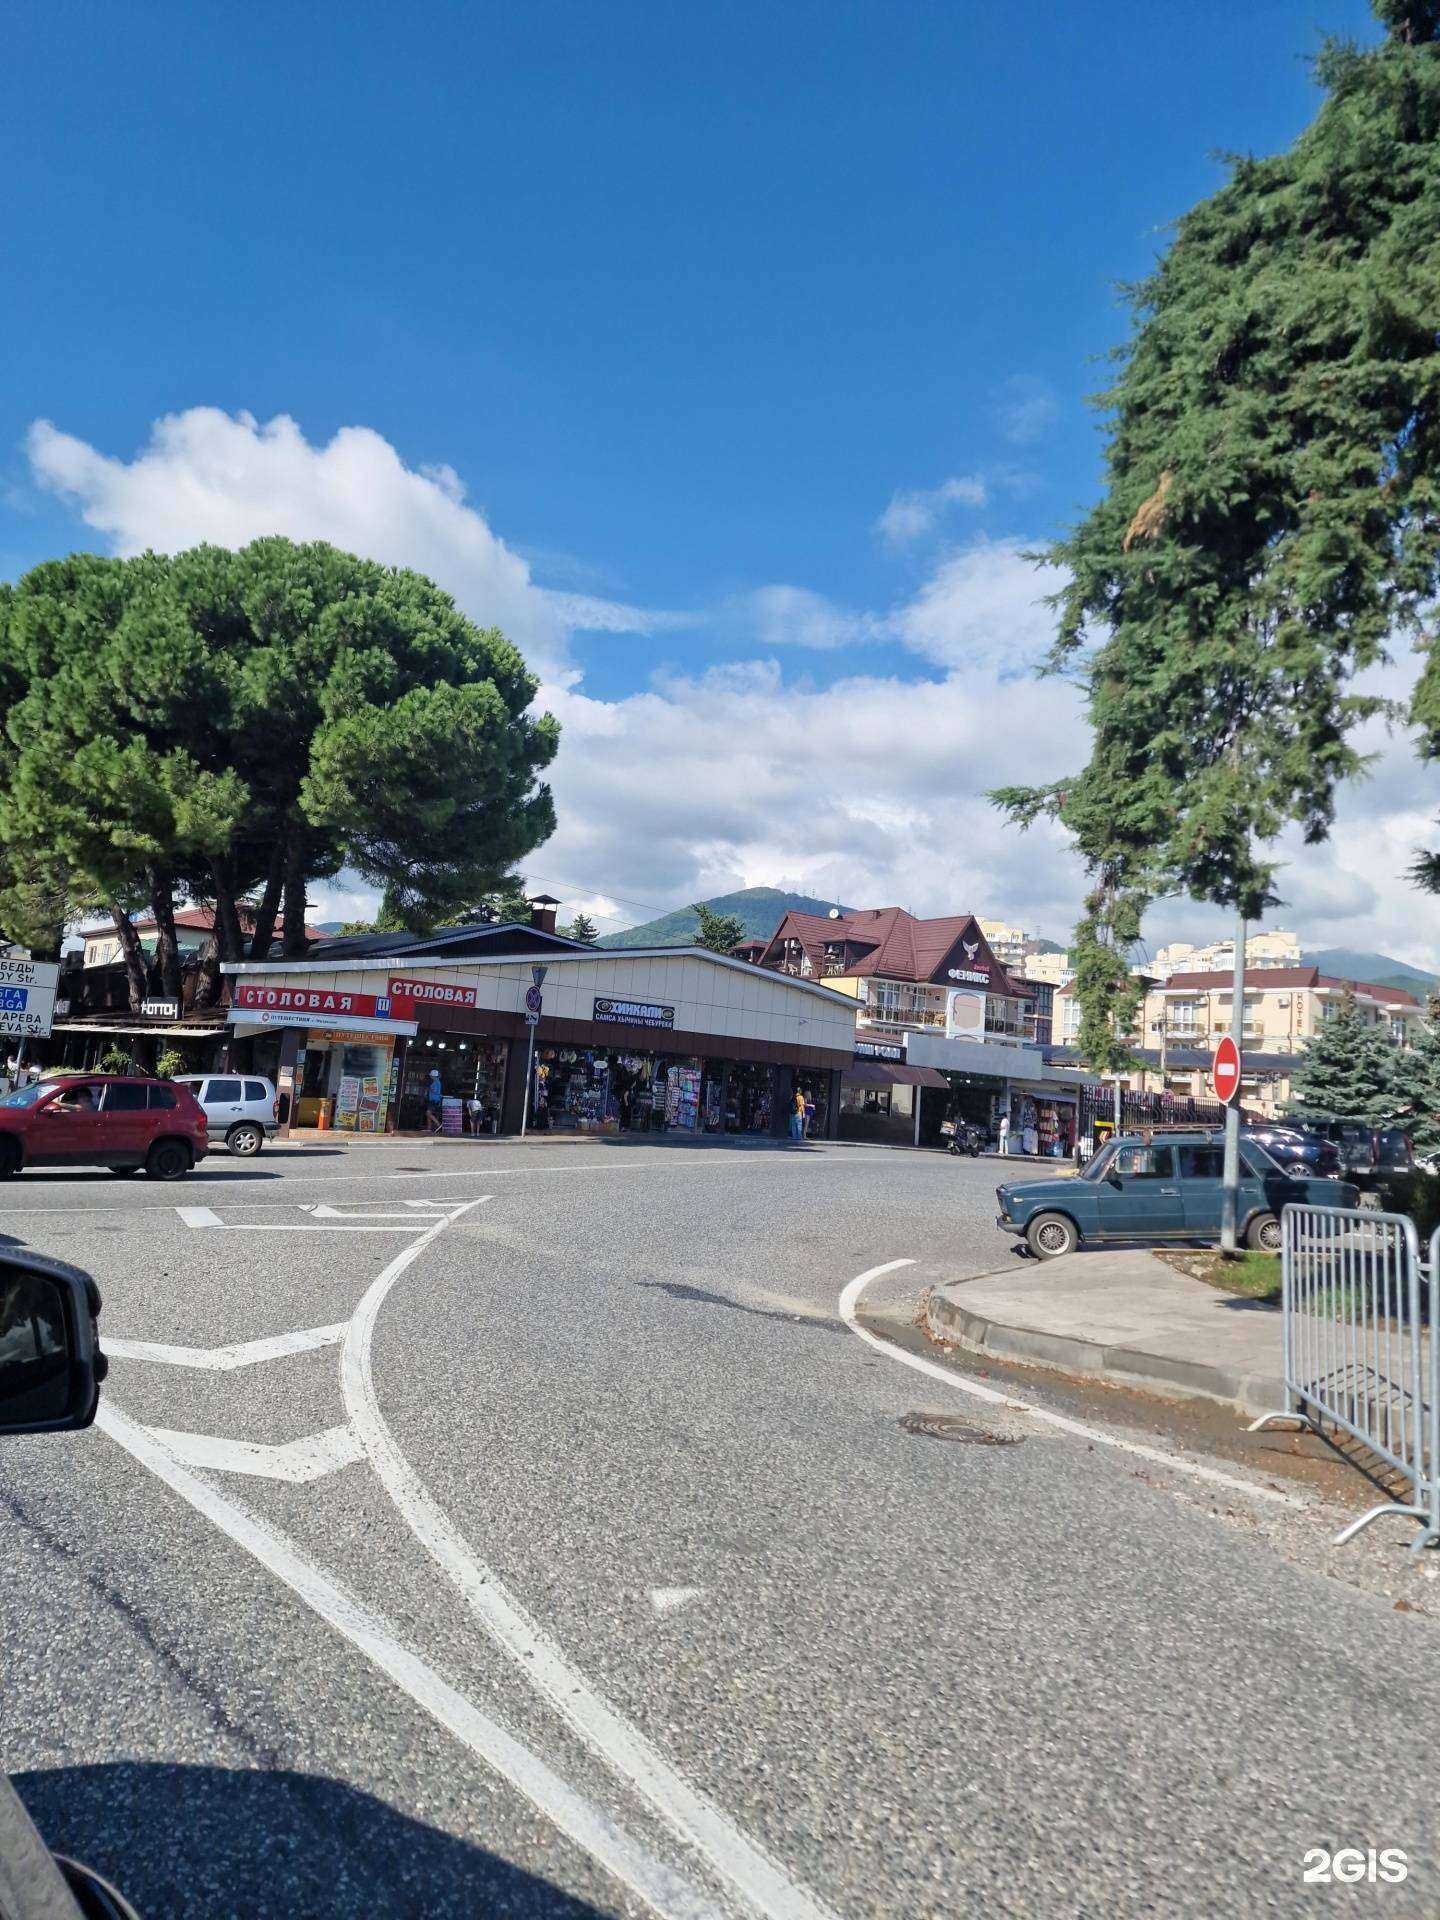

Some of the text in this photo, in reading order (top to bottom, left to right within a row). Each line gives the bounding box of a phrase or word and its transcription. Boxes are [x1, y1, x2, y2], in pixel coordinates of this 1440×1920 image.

[1, 962, 35, 974] БЕДЫ
[246, 990, 352, 1010] СТОЛОВАЯ
[391, 982, 475, 1003] СТОЛОВАЯ
[610, 1002, 662, 1019] ХИНКАЛИ
